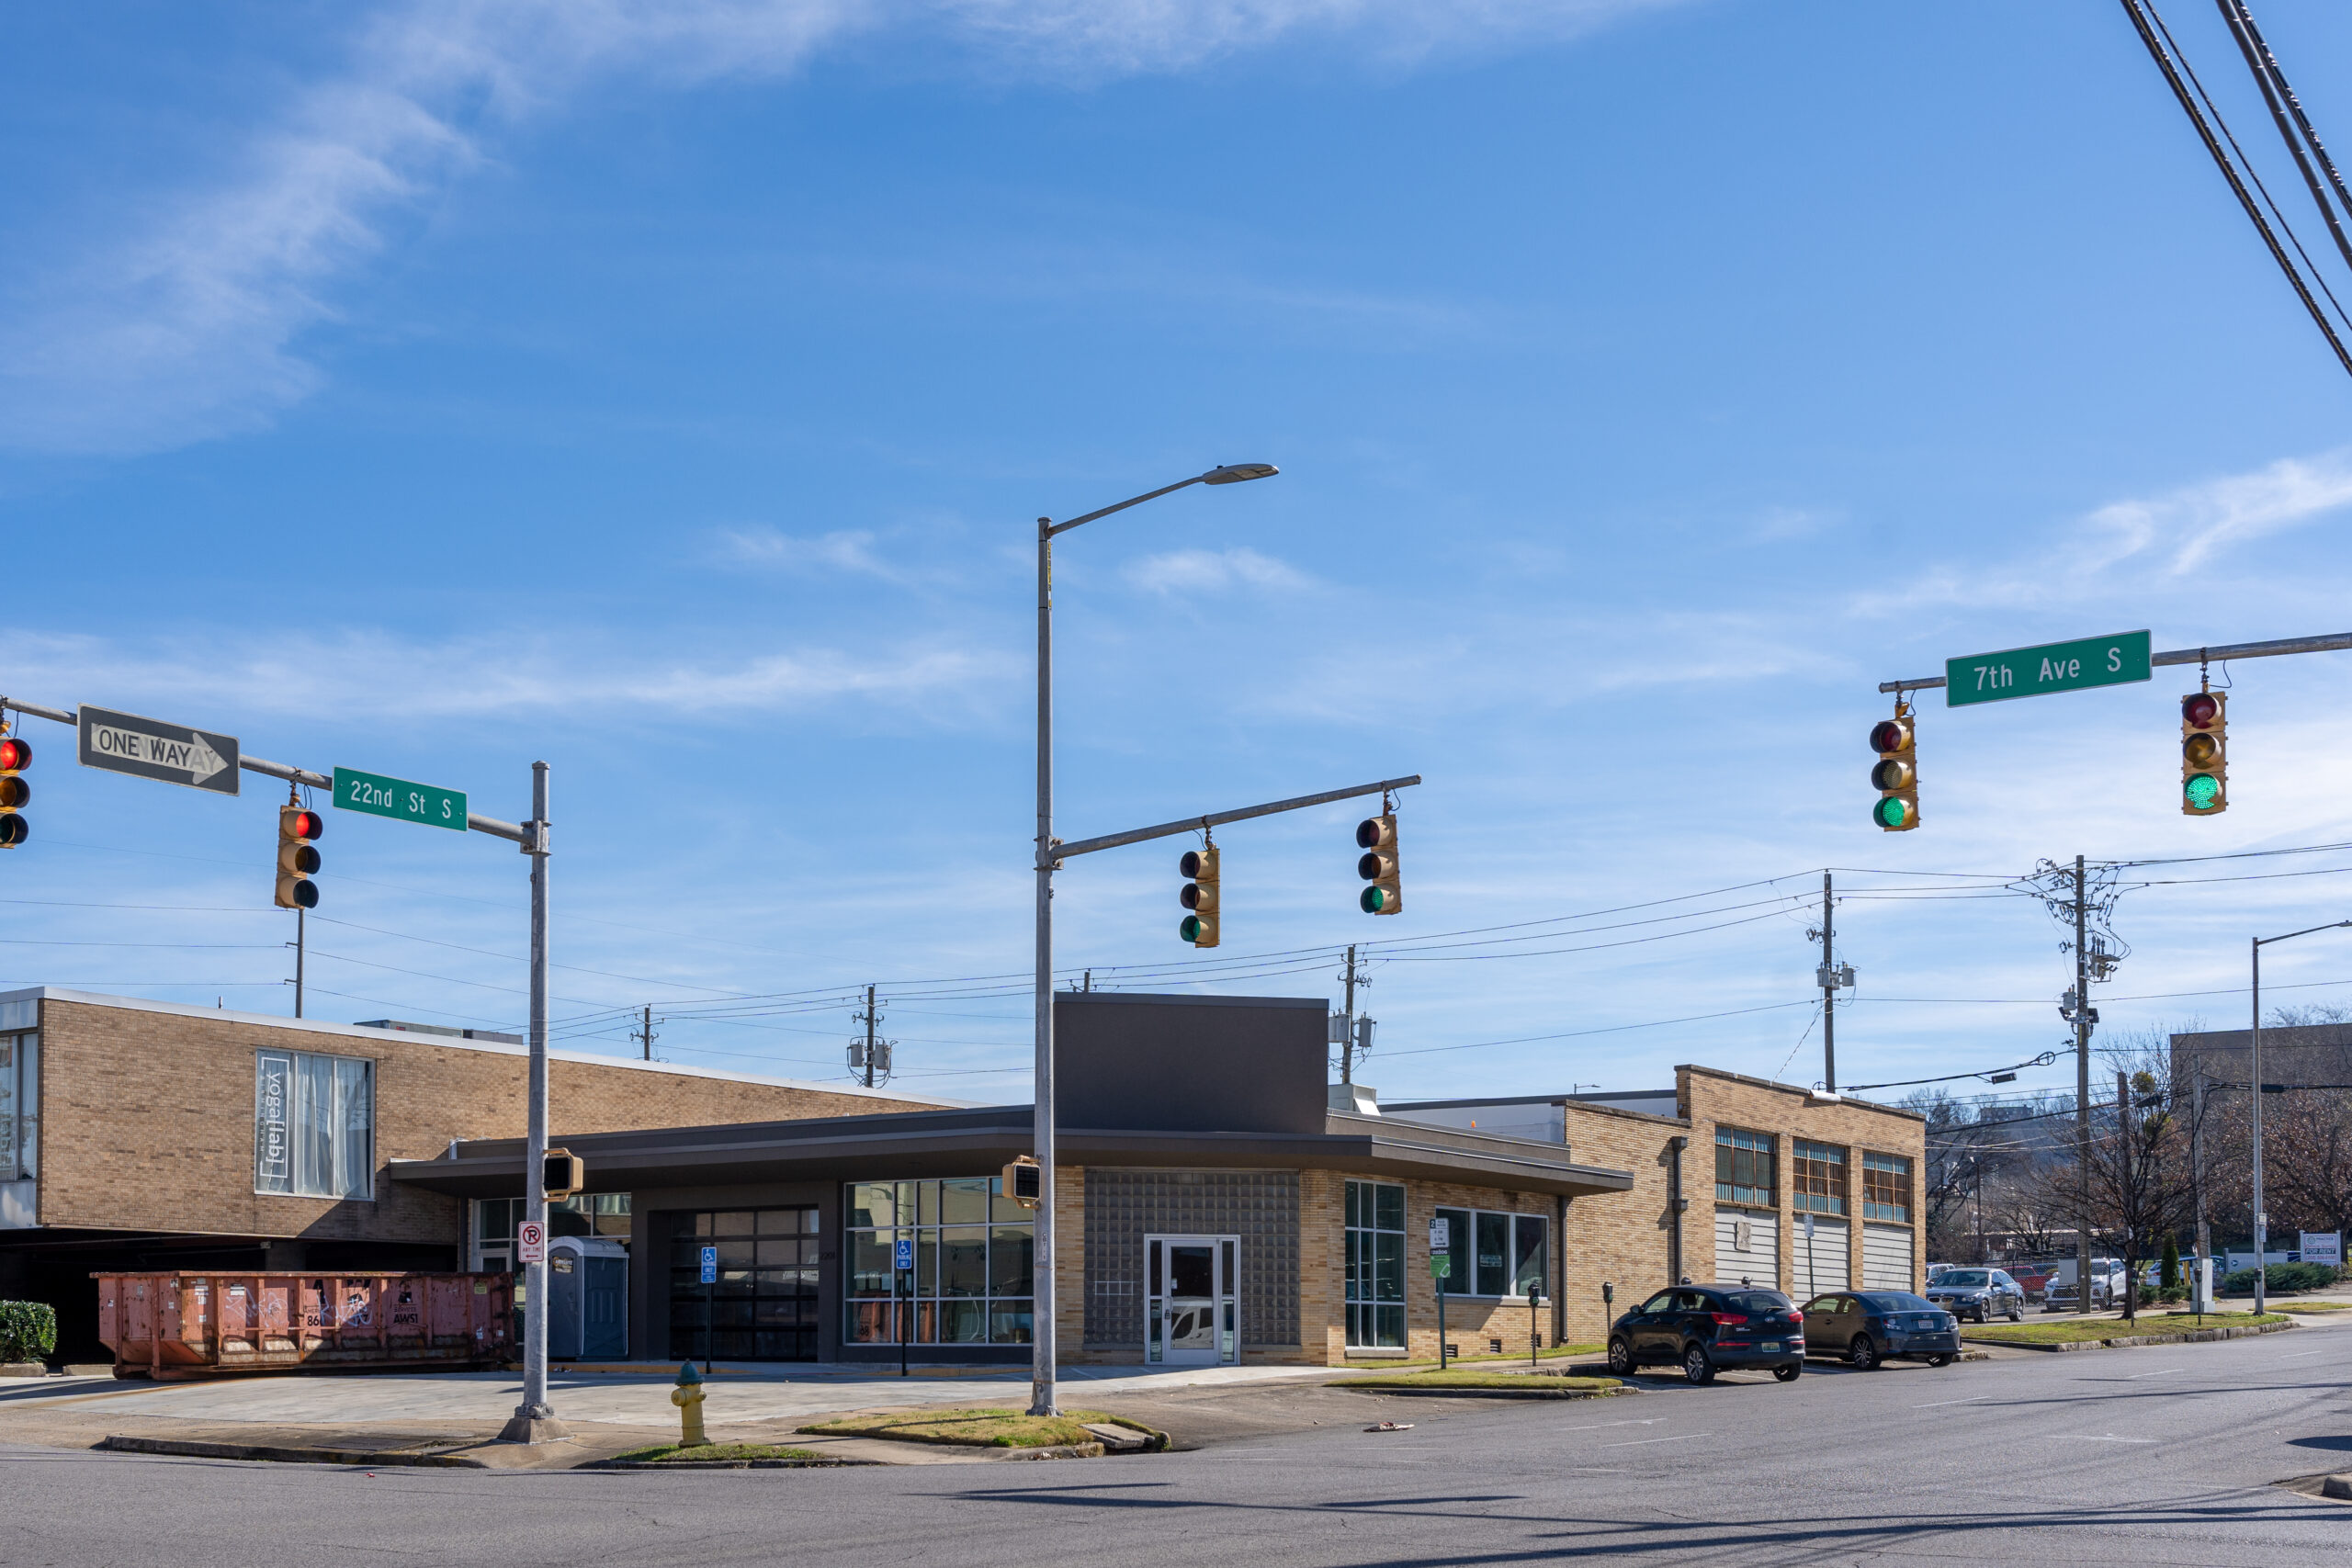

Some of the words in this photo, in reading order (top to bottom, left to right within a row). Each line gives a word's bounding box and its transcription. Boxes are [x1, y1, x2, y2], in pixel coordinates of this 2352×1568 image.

[1974, 664, 2013, 691] 7th
[2039, 658, 2080, 682] Ave
[2107, 648, 2121, 672] S
[99, 729, 140, 758] ONE
[150, 739, 191, 767] WAY
[351, 781, 392, 807] 22nd
[409, 792, 425, 814] St
[442, 798, 451, 818] S
